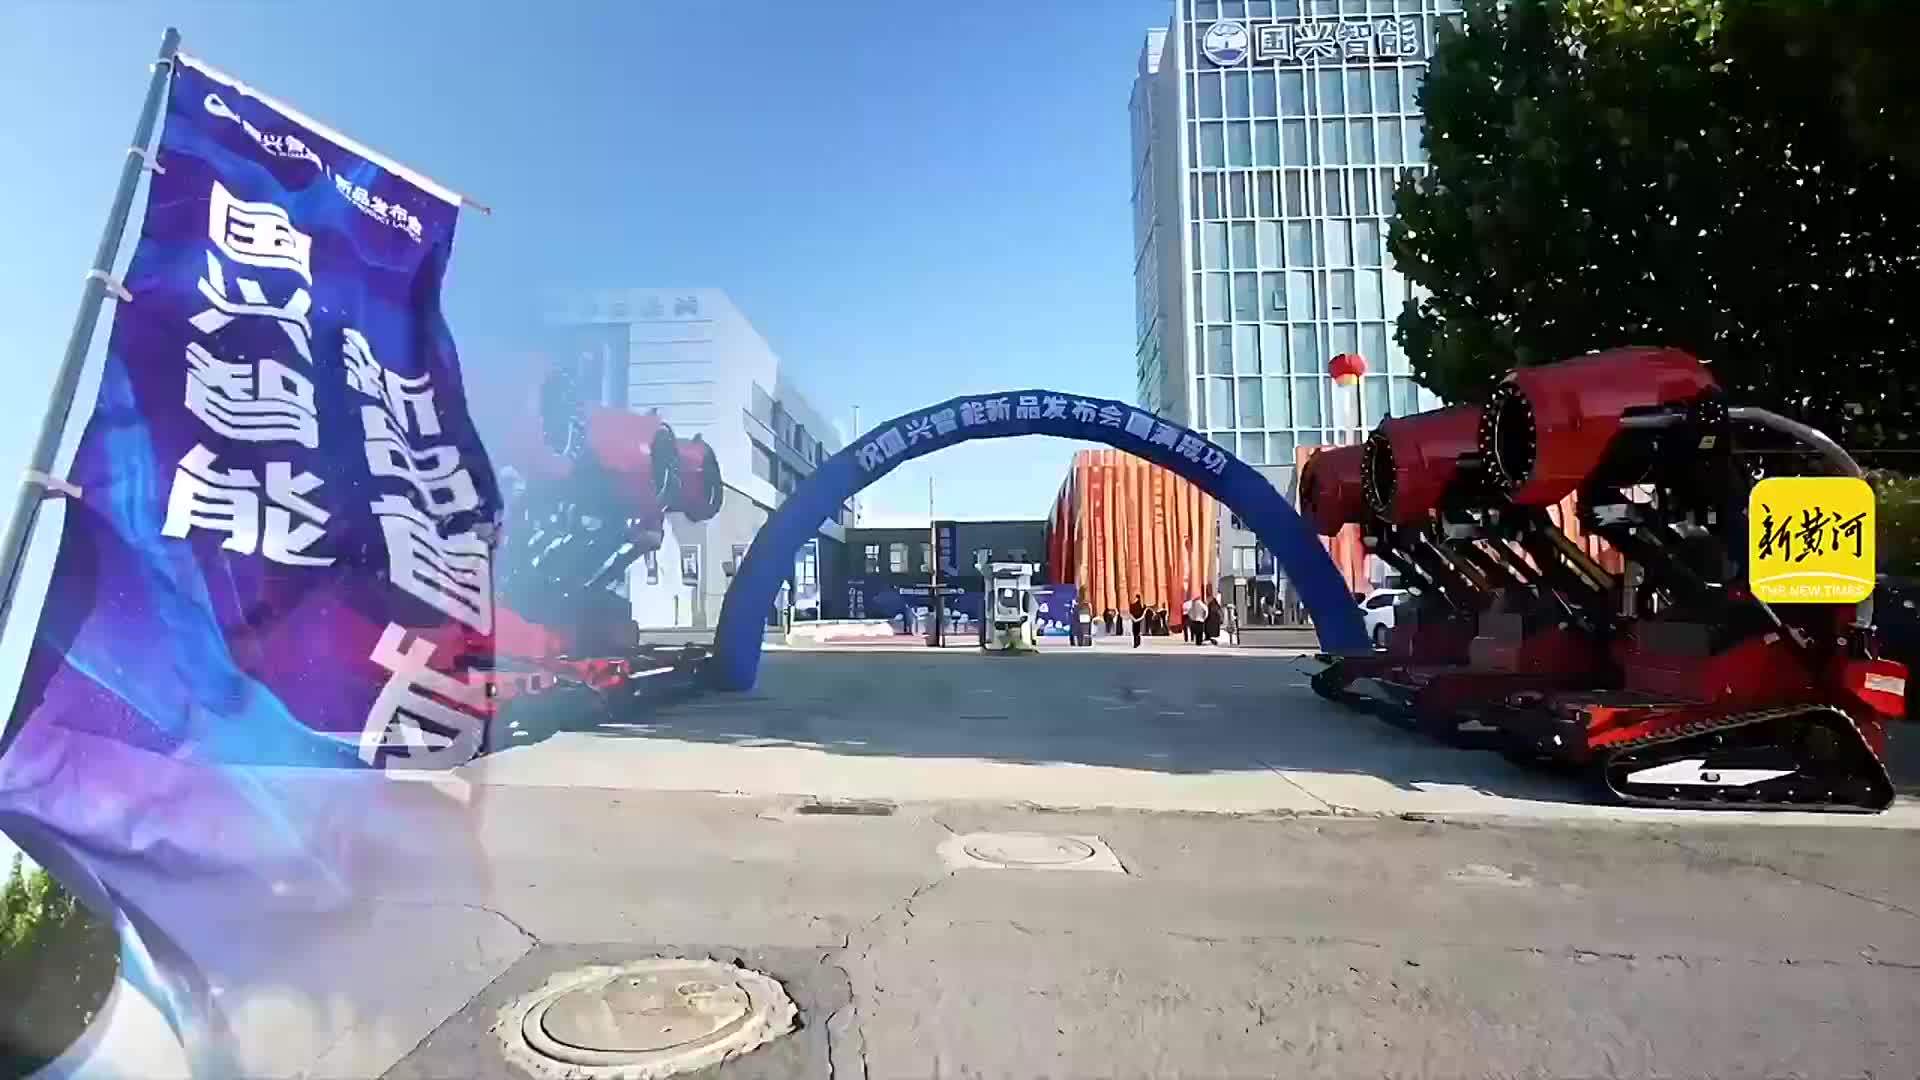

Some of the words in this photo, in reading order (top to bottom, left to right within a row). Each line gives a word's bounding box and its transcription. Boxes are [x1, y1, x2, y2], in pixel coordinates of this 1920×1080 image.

[1255, 20, 1418, 63] 国兴智能
[161, 179, 336, 567] 国兴智能
